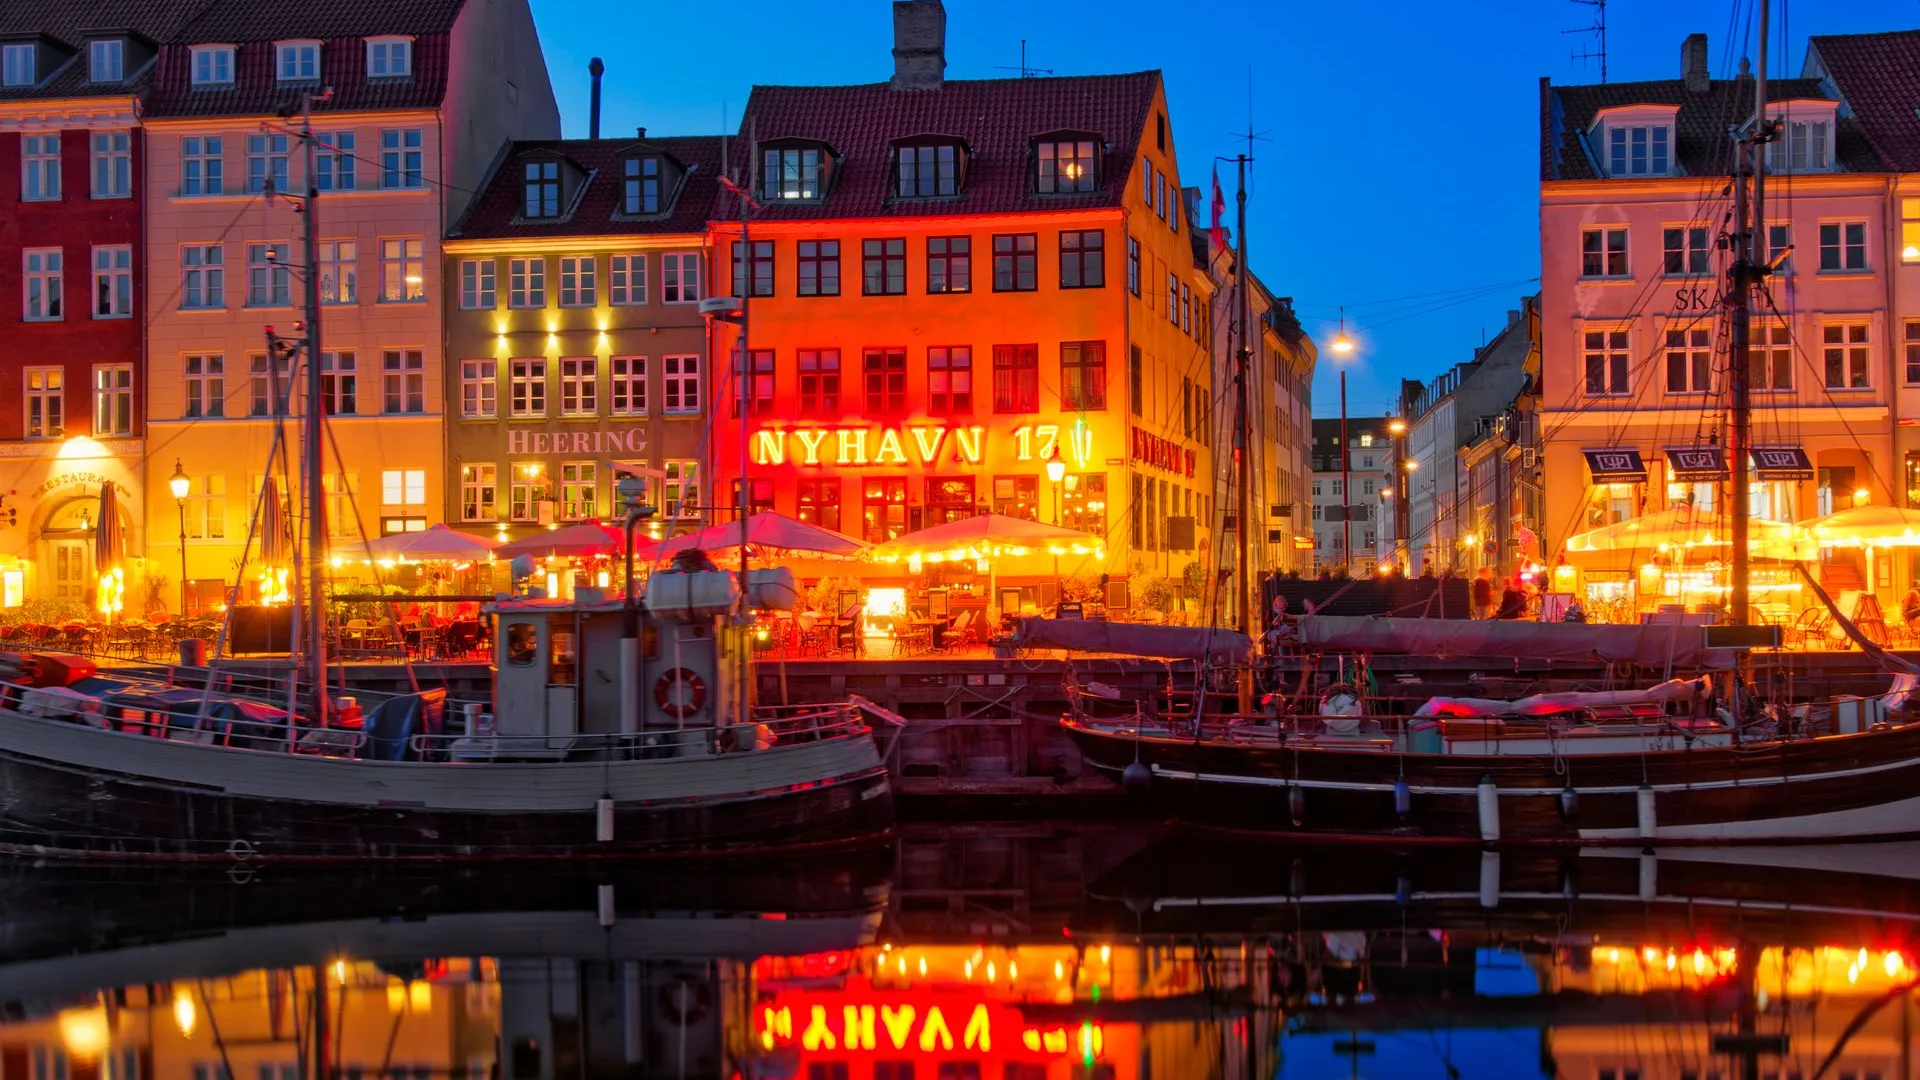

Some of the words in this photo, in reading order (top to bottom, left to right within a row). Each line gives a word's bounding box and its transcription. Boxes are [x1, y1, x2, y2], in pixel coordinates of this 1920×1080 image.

[506, 427, 649, 454] HEERING
[757, 427, 984, 464] NYHAVN
[1013, 425, 1059, 461] 17
[36, 472, 126, 497] RESTAURAT
